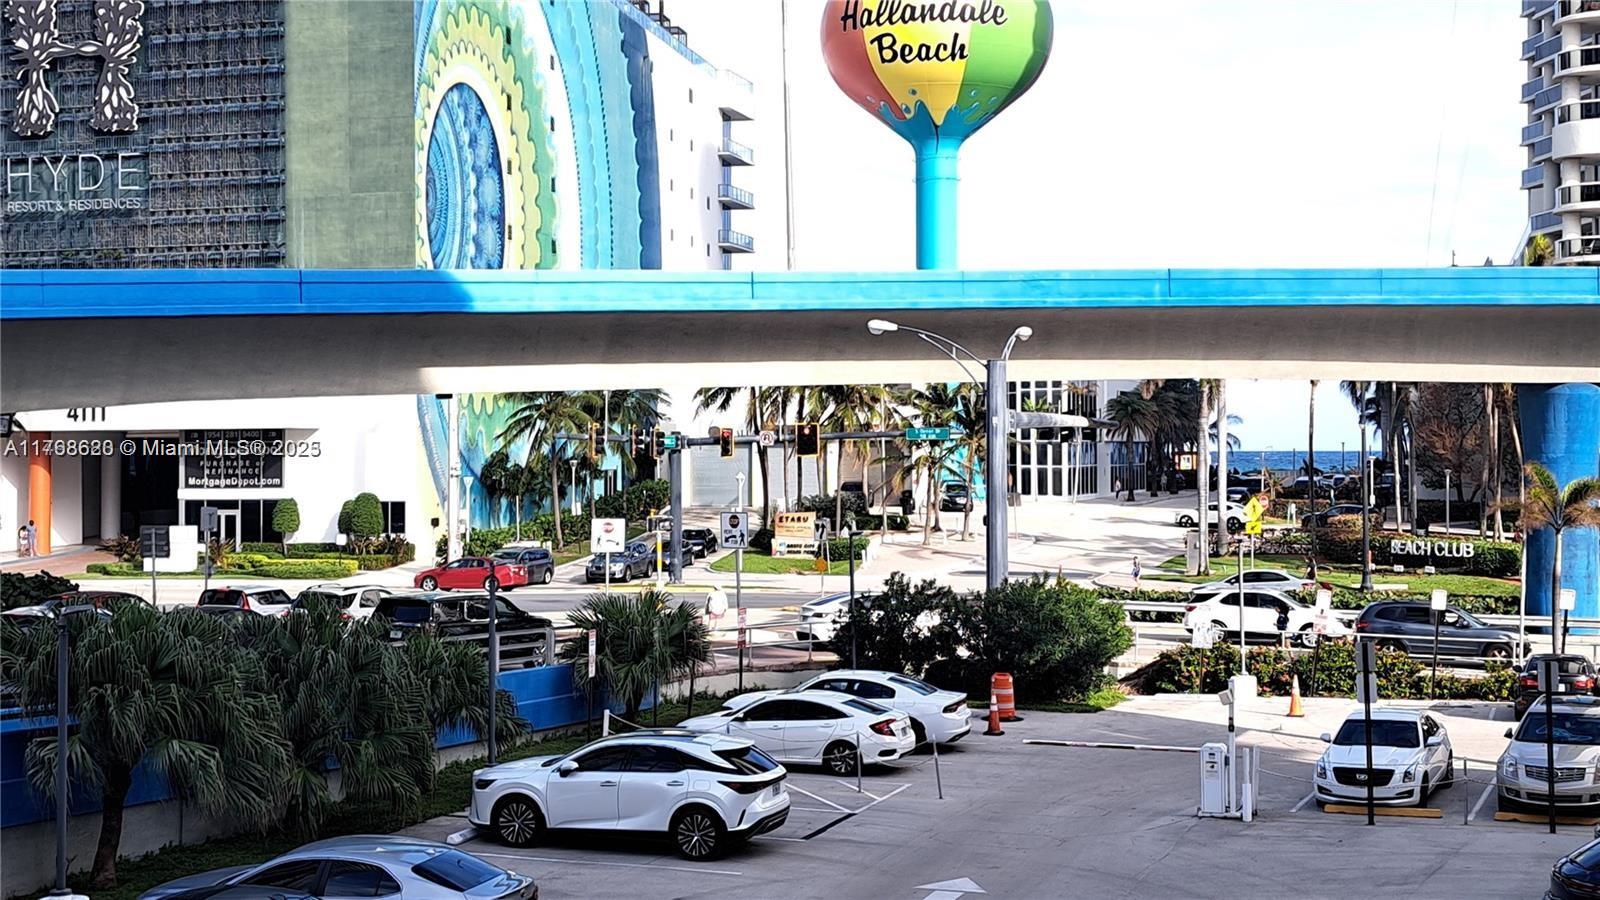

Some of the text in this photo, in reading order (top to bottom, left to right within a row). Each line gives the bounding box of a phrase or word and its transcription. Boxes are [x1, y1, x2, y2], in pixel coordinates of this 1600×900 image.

[841, 0, 1008, 32] Hallandale
[869, 32, 968, 64] Beach
[6, 153, 142, 194] HYDE
[7, 197, 141, 212] RESORT & RESIDENCES
[66, 407, 106, 422] 4111
[1390, 539, 1475, 557] BEACH CLUB
